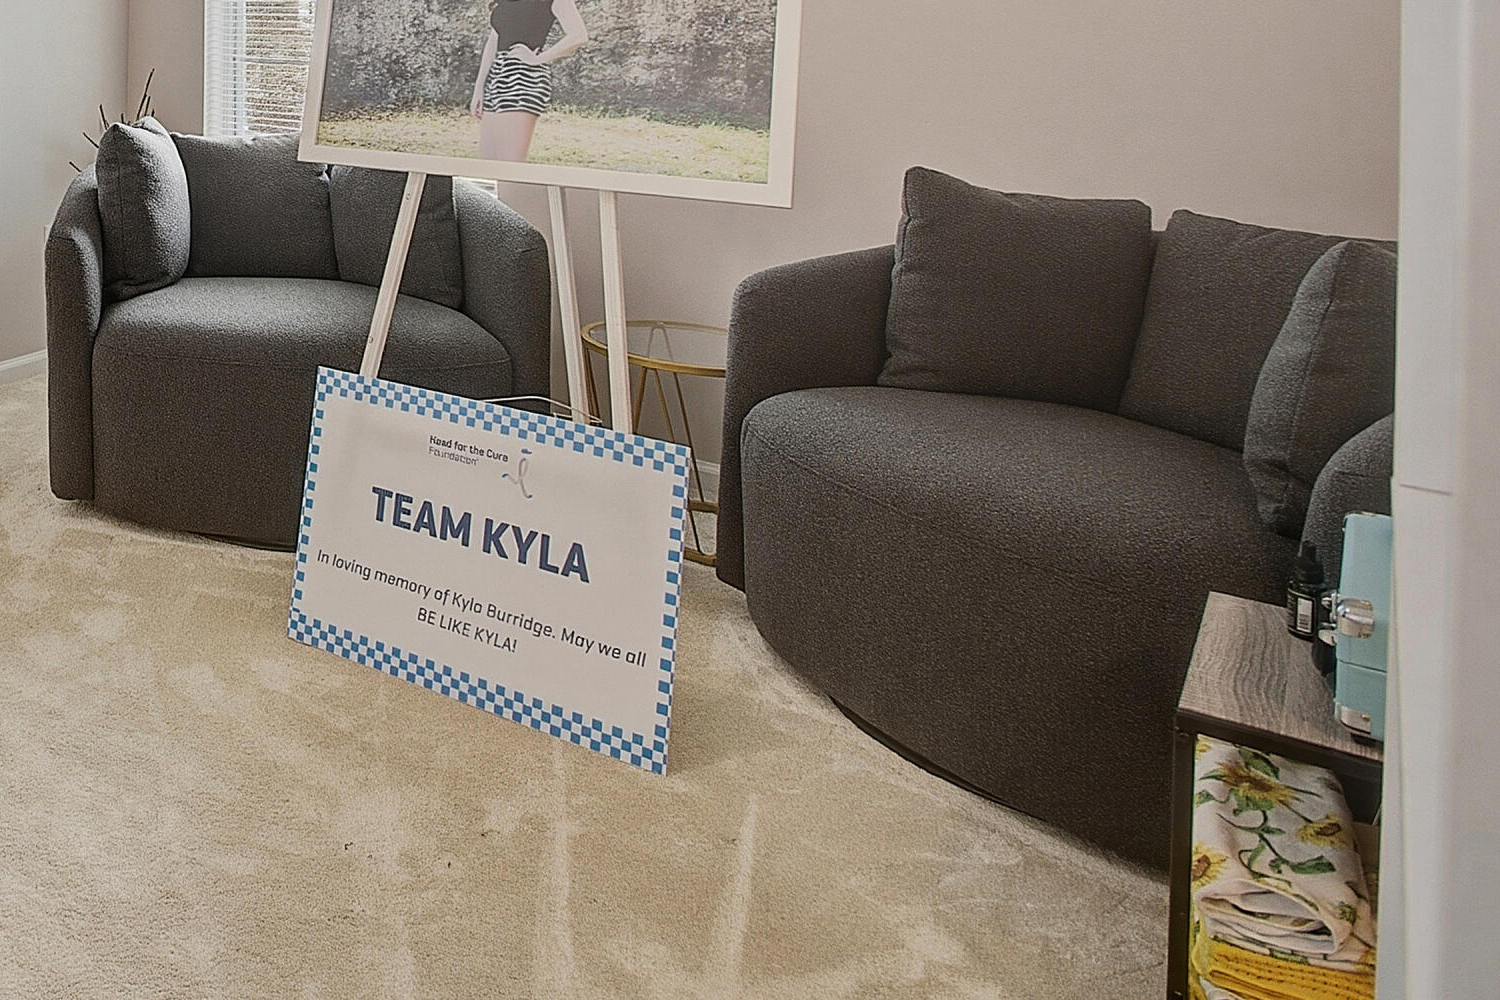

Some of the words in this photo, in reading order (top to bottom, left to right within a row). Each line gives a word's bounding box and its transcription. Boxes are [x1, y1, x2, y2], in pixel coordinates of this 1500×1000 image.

[429, 435, 452, 449] Head
[454, 440, 468, 452] for
[469, 445, 485, 457] the
[486, 448, 509, 462] Cure
[371, 486, 472, 548] TEAM
[482, 517, 590, 584] KYLA
[317, 549, 330, 565] In
[332, 553, 372, 581] loving
[373, 569, 431, 600] memory
[433, 588, 451, 606] of
[451, 591, 483, 614] Kyla
[486, 603, 556, 639] Burridge.
[560, 627, 595, 654] May
[597, 641, 622, 660] we
[625, 650, 647, 667] all
[416, 606, 437, 626] BE
[439, 613, 472, 638] LIKE
[473, 626, 518, 654] KYLA!
